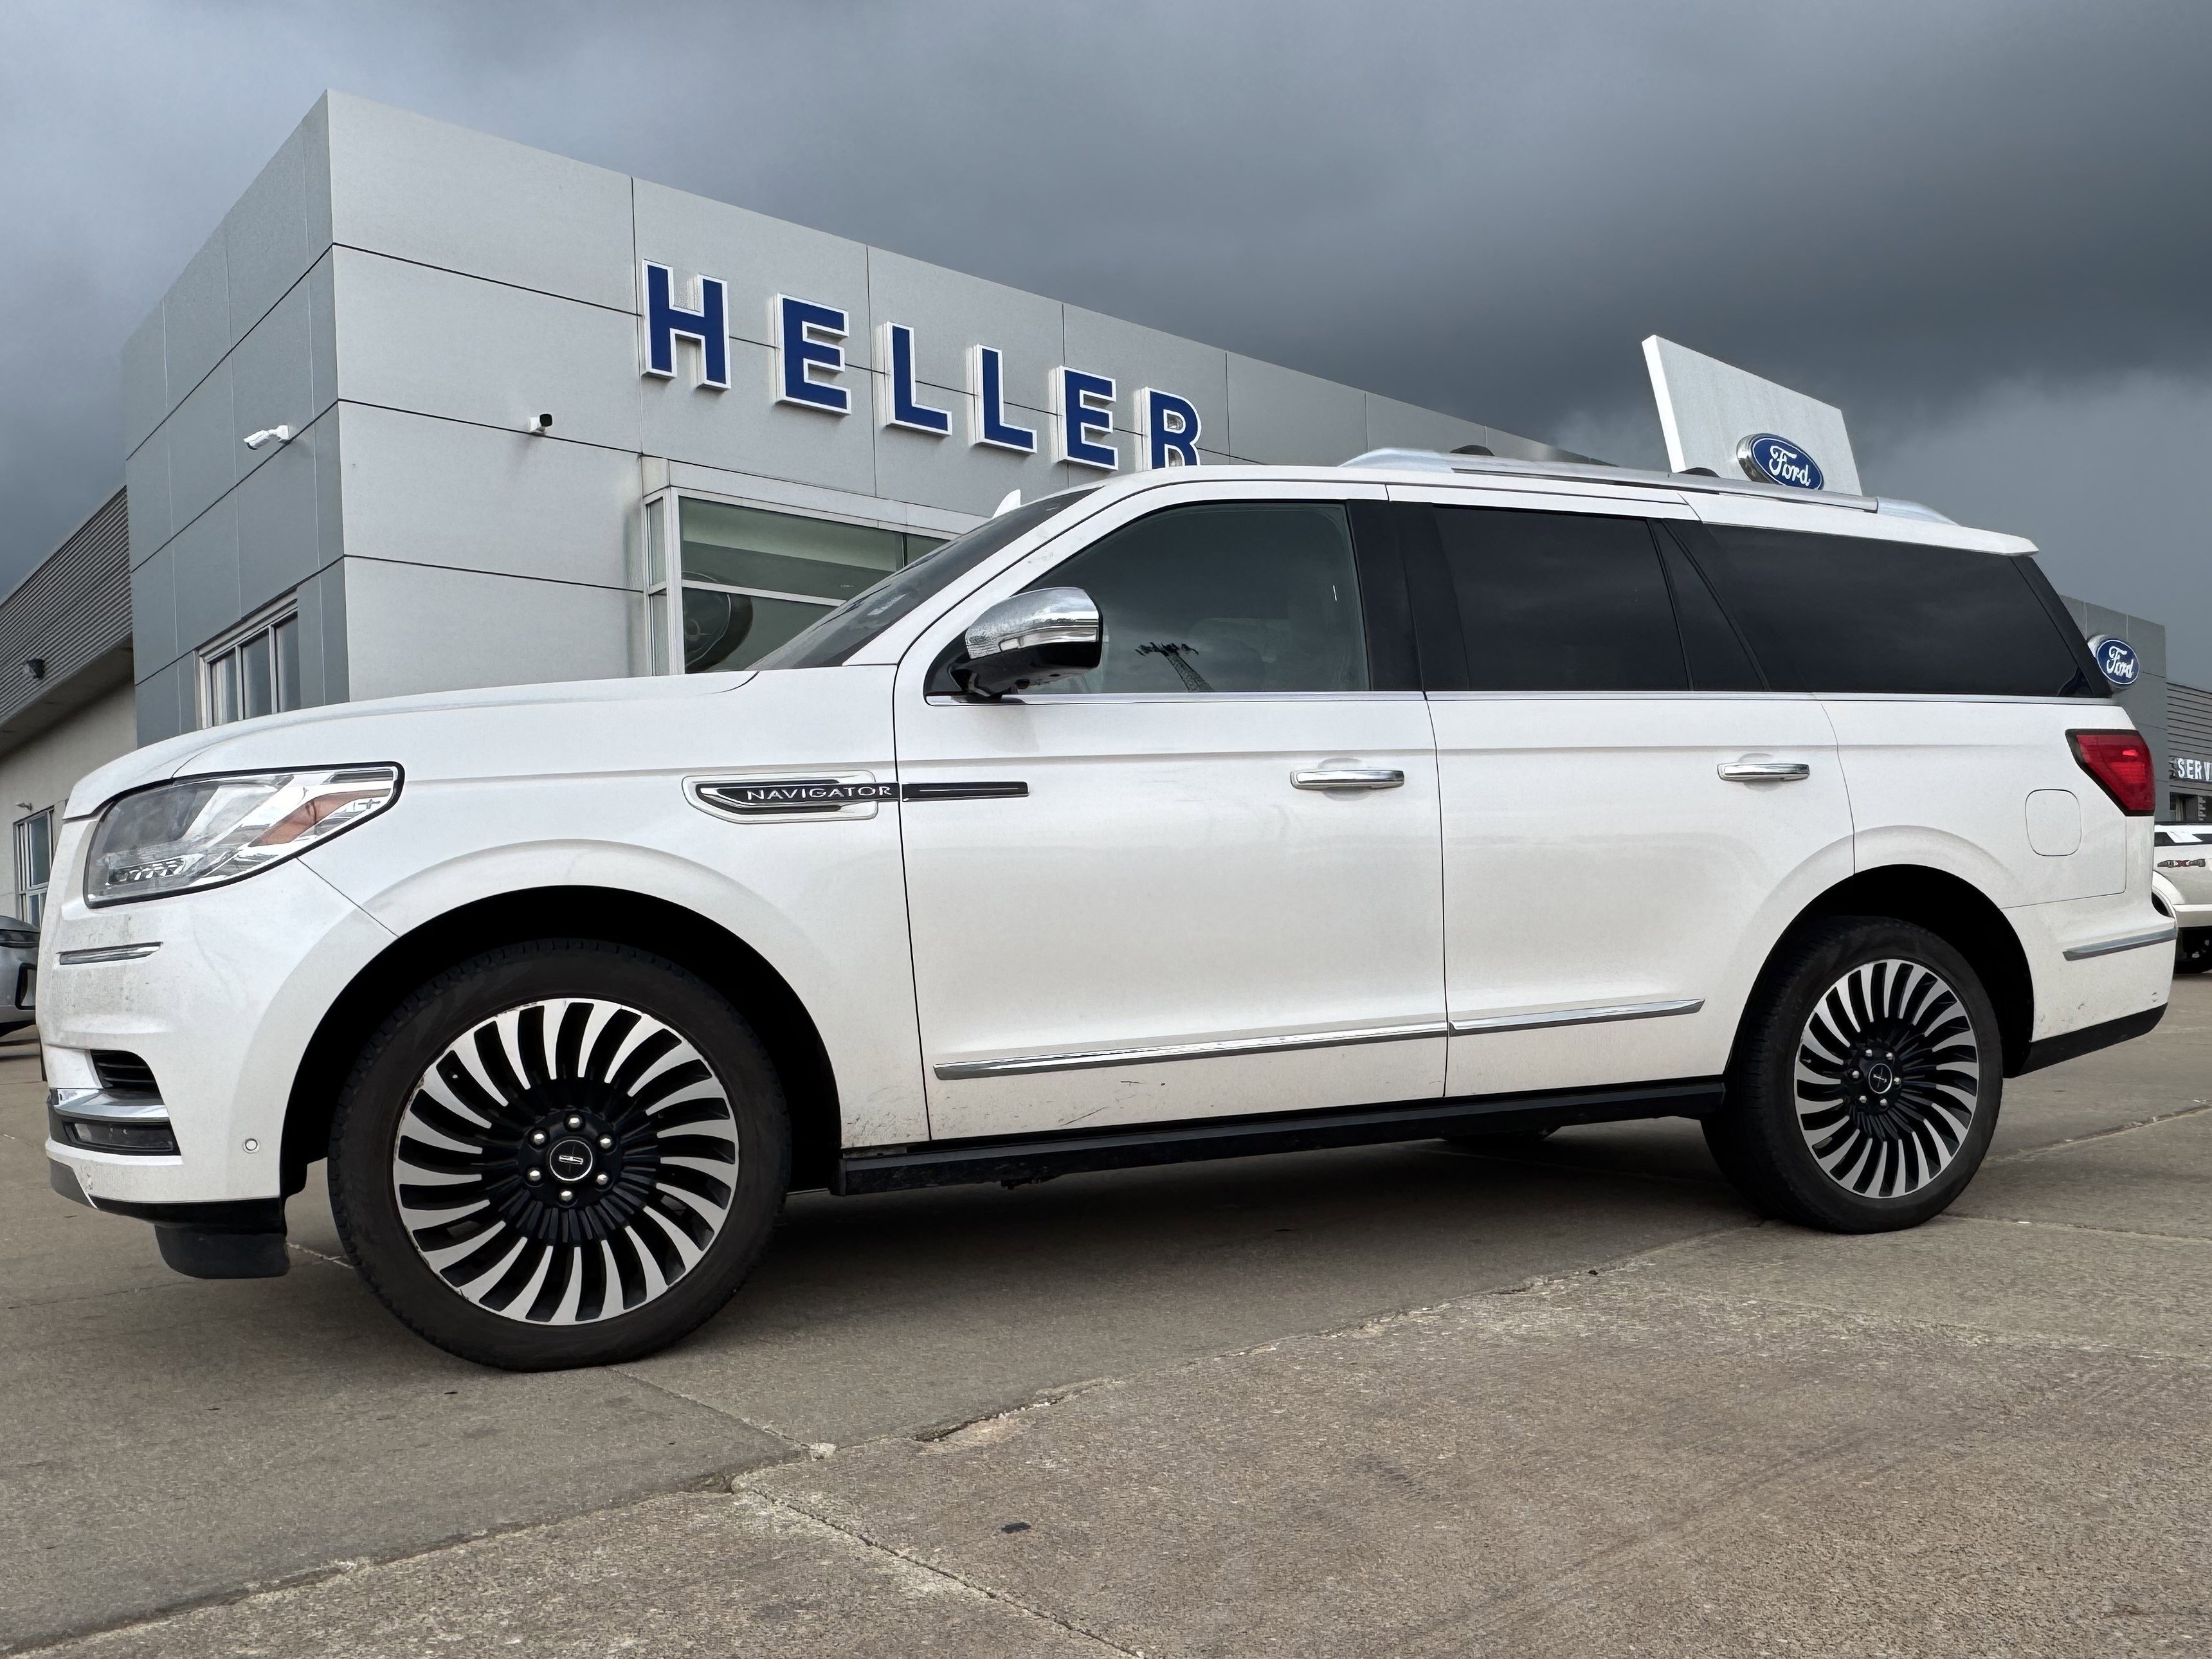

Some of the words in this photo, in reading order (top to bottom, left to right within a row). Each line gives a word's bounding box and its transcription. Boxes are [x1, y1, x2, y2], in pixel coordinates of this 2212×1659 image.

[642, 259, 1202, 471] HELLER
[1769, 445, 1811, 486] Ford
[2107, 646, 2134, 678] Ford
[746, 785, 893, 801] NAVIGATOR
